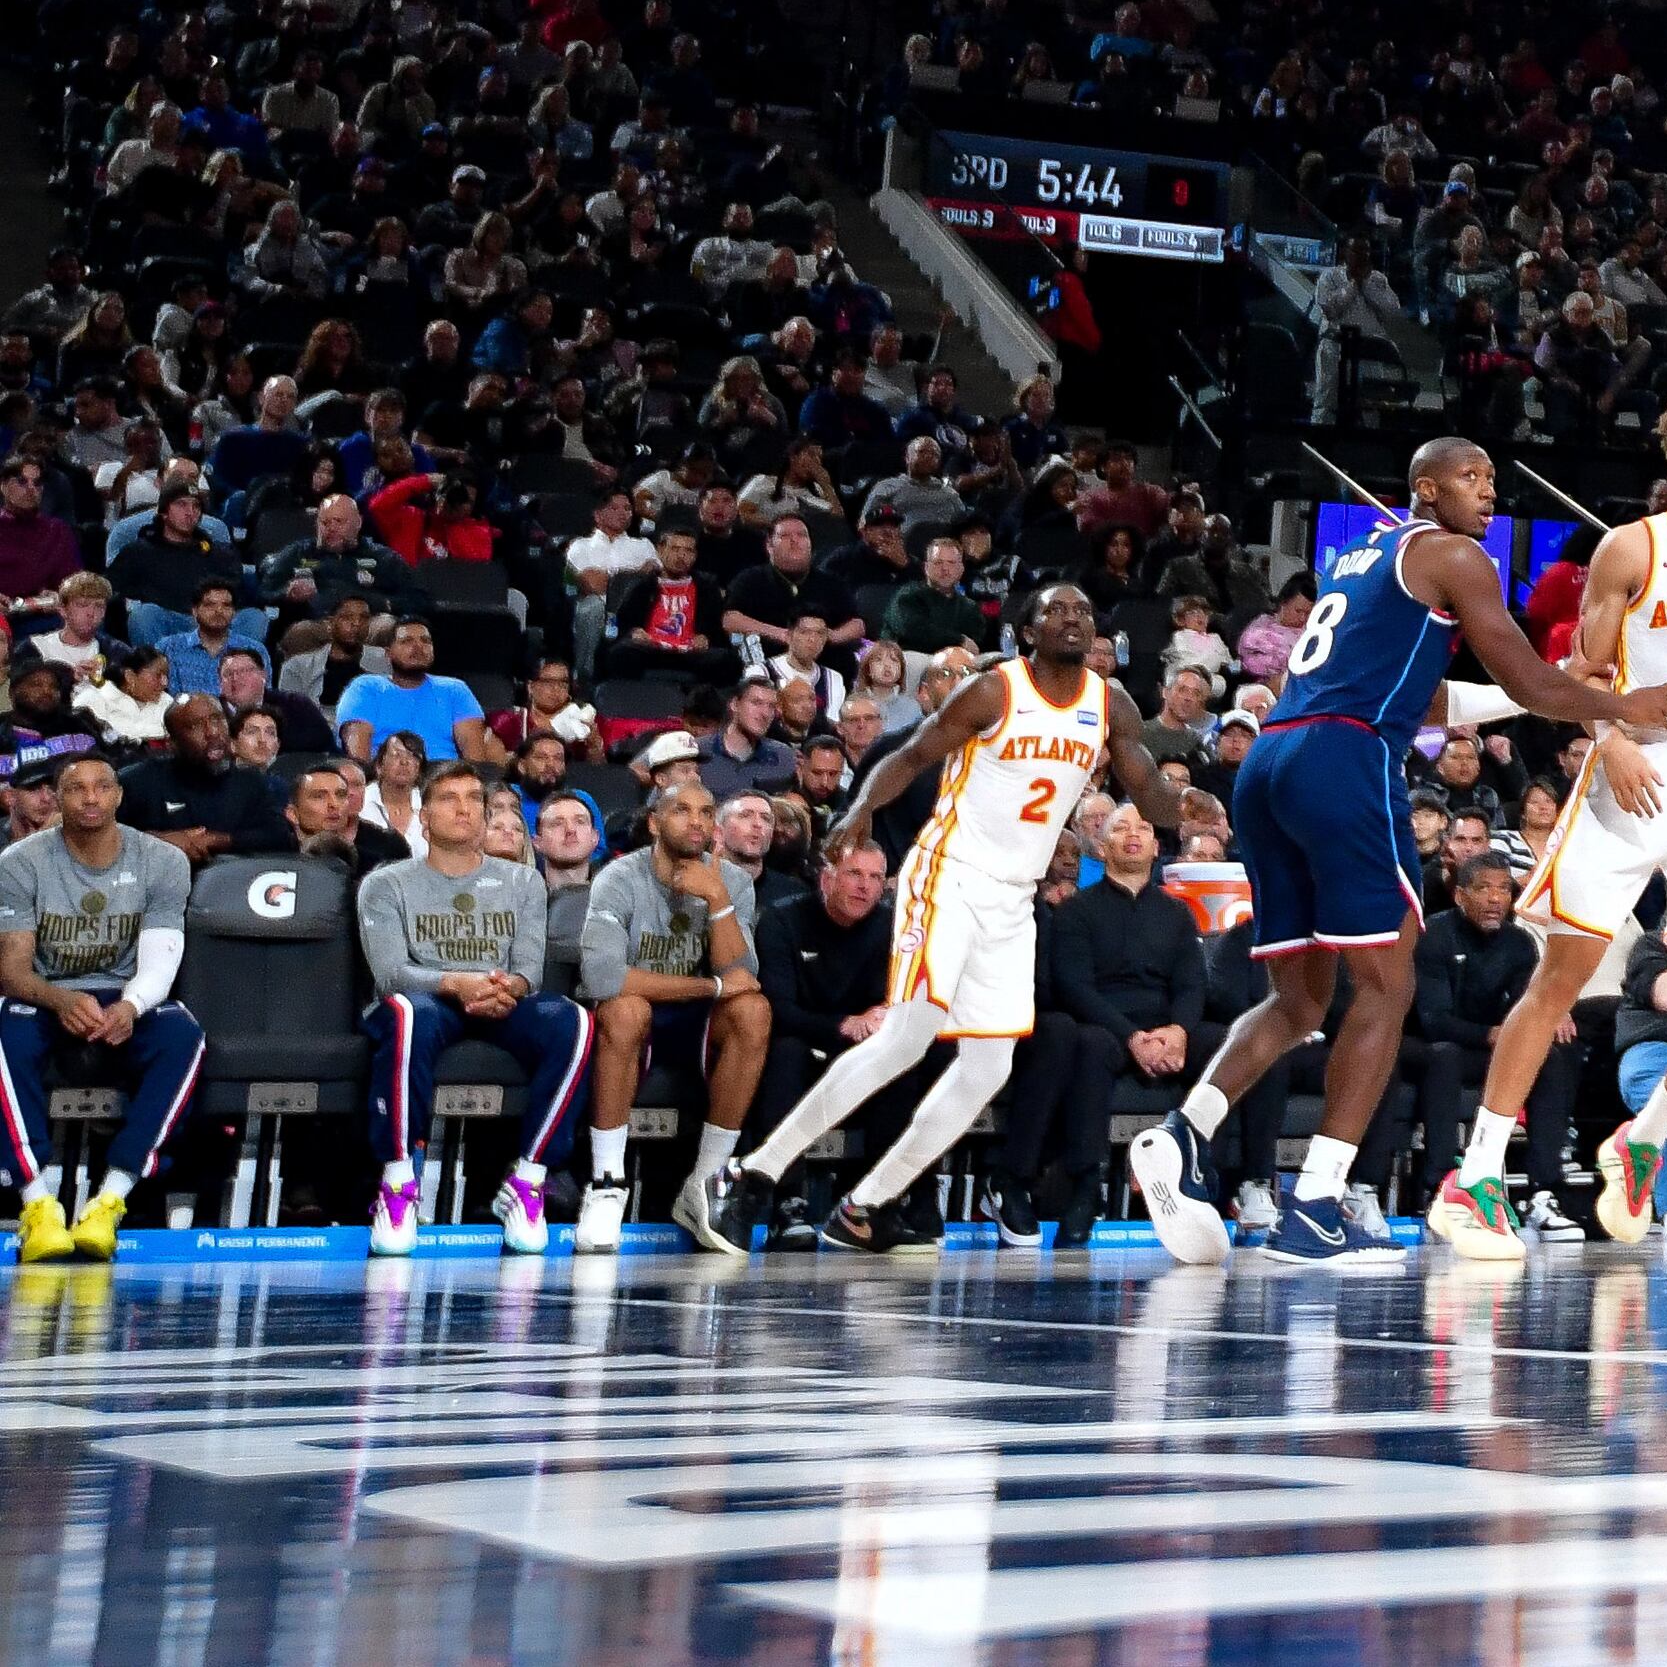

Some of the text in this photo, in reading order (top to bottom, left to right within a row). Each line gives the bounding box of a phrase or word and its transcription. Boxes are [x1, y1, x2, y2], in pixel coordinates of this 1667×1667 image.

[1037, 157, 1123, 208] 5:44
[1287, 591, 1349, 676] 8
[1018, 776, 1057, 825] 2
[247, 870, 297, 918] G
